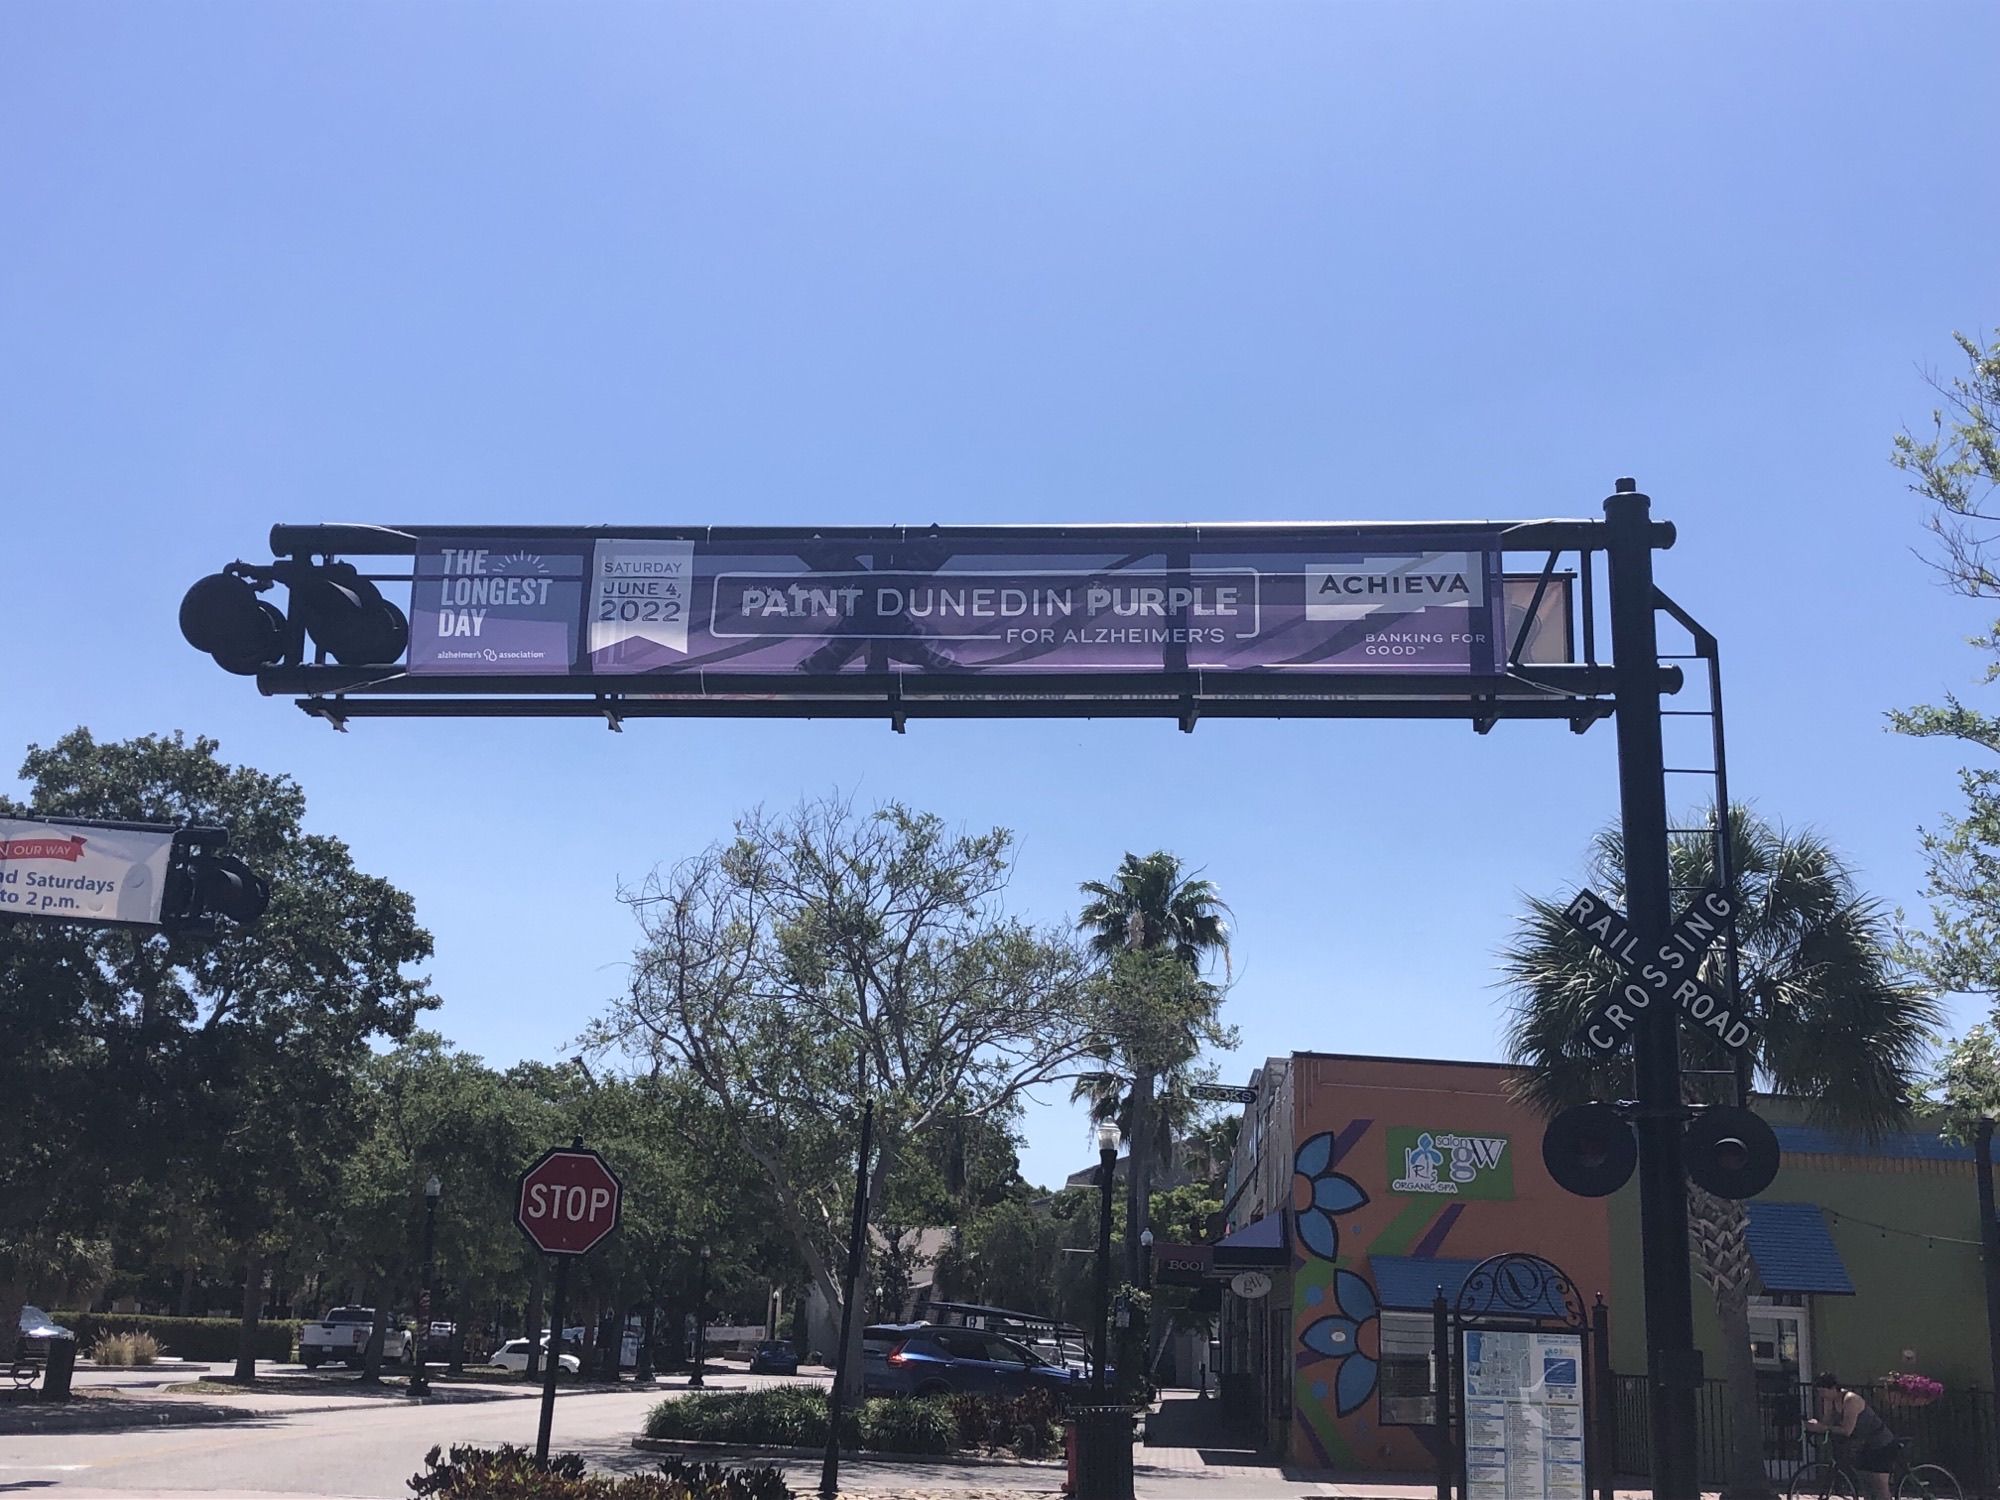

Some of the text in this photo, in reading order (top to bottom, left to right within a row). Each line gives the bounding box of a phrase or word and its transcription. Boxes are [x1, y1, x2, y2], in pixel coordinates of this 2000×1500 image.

[441, 549, 489, 574] THE
[604, 562, 682, 574] SATURDAY
[441, 578, 552, 605] LONGEST
[603, 582, 682, 598] JUNE 4,
[1319, 573, 1470, 594] ACHIEVA
[741, 585, 1238, 617] PAINT DUNEDIN PURPLE
[600, 600, 681, 622] 2022
[438, 609, 488, 637] DAY
[1007, 628, 1225, 643] FOR ALZHEIMER'S
[1365, 633, 1486, 644] BANKING FOR
[437, 650, 482, 660] alzheimer's
[14, 845, 42, 856] OUR
[47, 846, 72, 856] WAY
[26, 872, 115, 896] Saturdays
[26, 892, 37, 906] 2
[42, 896, 80, 910] p.m.
[1569, 896, 1750, 1048] RAIL ROAD
[1588, 893, 1730, 1048] CROSSING
[1192, 1087, 1252, 1101] BOOKS
[1436, 1135, 1468, 1148] salon
[1394, 1181, 1456, 1192] ORGANIC SPA
[528, 1184, 610, 1222] STOP
